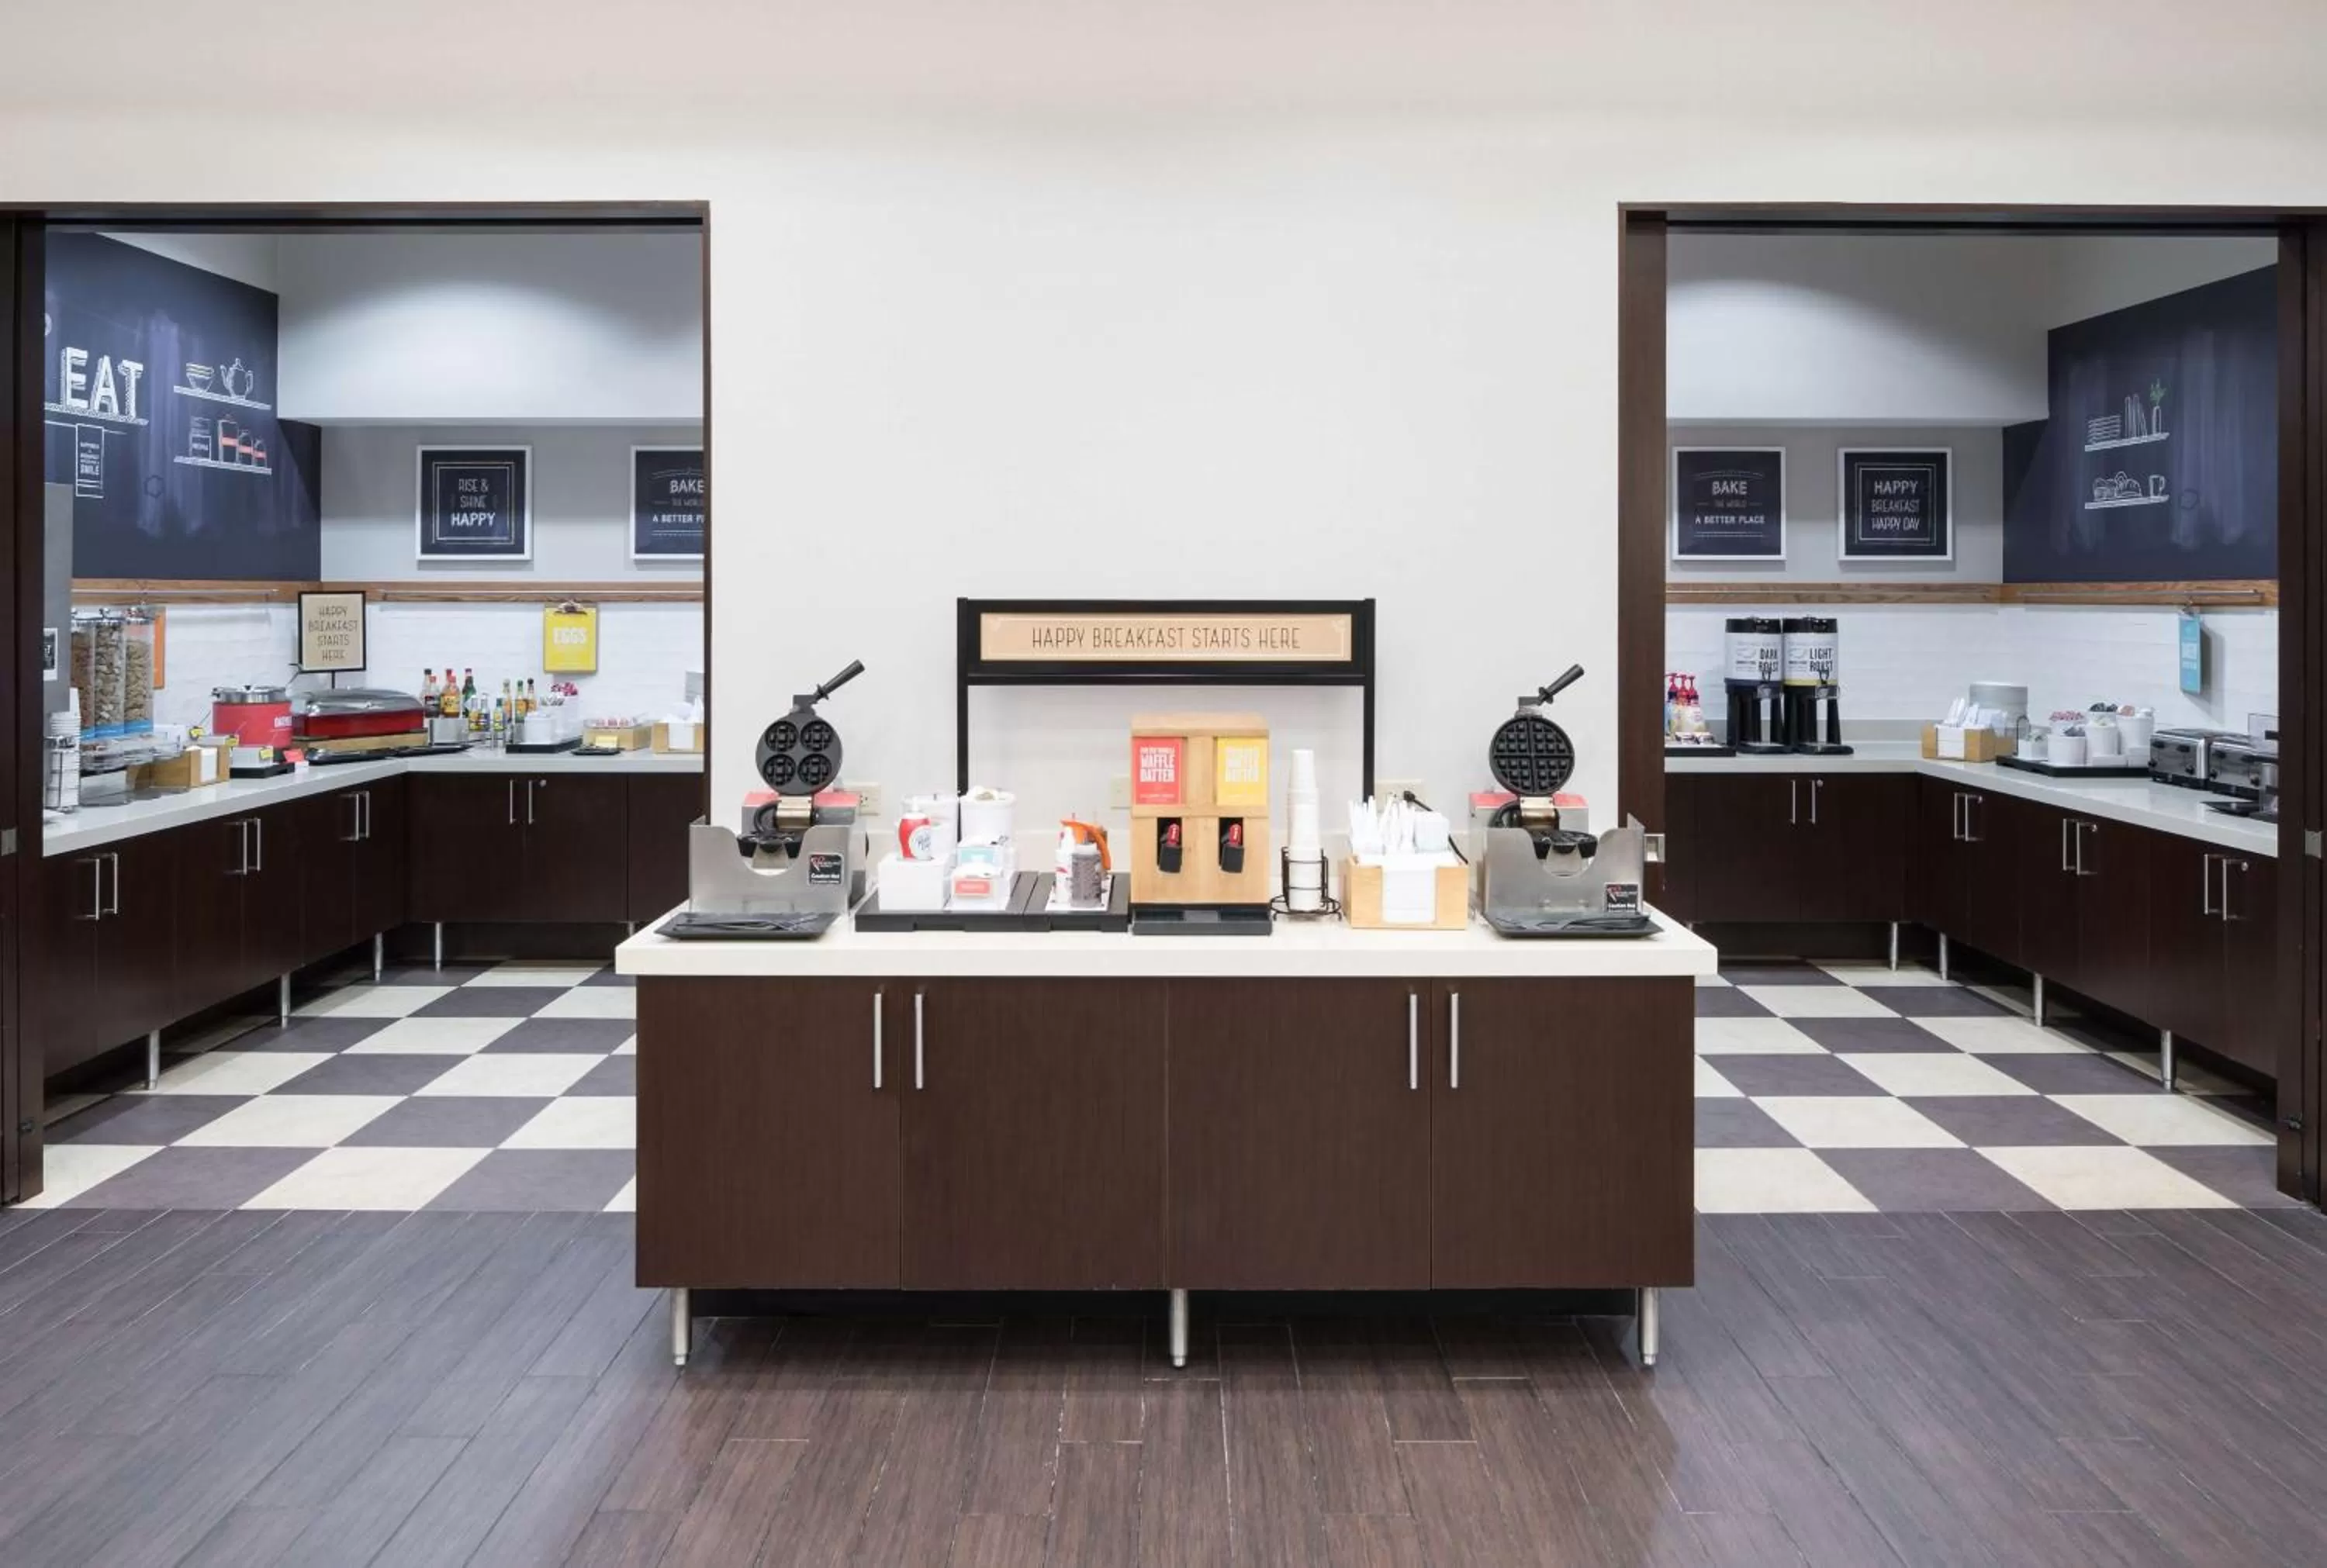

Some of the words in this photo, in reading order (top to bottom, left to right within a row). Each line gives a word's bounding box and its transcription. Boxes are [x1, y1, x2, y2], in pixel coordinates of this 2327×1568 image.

[61, 346, 144, 420] EAT
[458, 478, 479, 492] RISE
[480, 478, 489, 492] &
[669, 478, 705, 494] BAKE
[1712, 480, 1748, 496] BAKE
[1874, 480, 1919, 495] HAPPY
[459, 494, 486, 509] SHINE
[1871, 499, 1921, 513] BREAKFAST
[451, 512, 496, 527] HAPPY
[662, 514, 693, 523] BETTER
[1695, 514, 1701, 524] A
[1704, 515, 1735, 524] BETTER
[1738, 515, 1765, 524] PLACE
[1871, 516, 1900, 530] HAPPY
[1903, 516, 1921, 530] DAY
[319, 605, 348, 617] HAPPY
[308, 620, 358, 633] BREAKFAST
[316, 634, 350, 647] STARTS
[553, 627, 587, 645] EGGS
[1032, 627, 1086, 650] HAPPY
[1092, 627, 1186, 650] BREAKFAST
[1191, 627, 1252, 650] STARTS
[1258, 627, 1302, 650] HERE
[322, 649, 346, 661] HERE
[1760, 648, 1778, 659] DARK
[1810, 648, 1832, 659] LIGHT
[1810, 660, 1833, 672] ROAST
[1140, 754, 1174, 768] WAFFLE
[1139, 768, 1175, 782] BATTER
